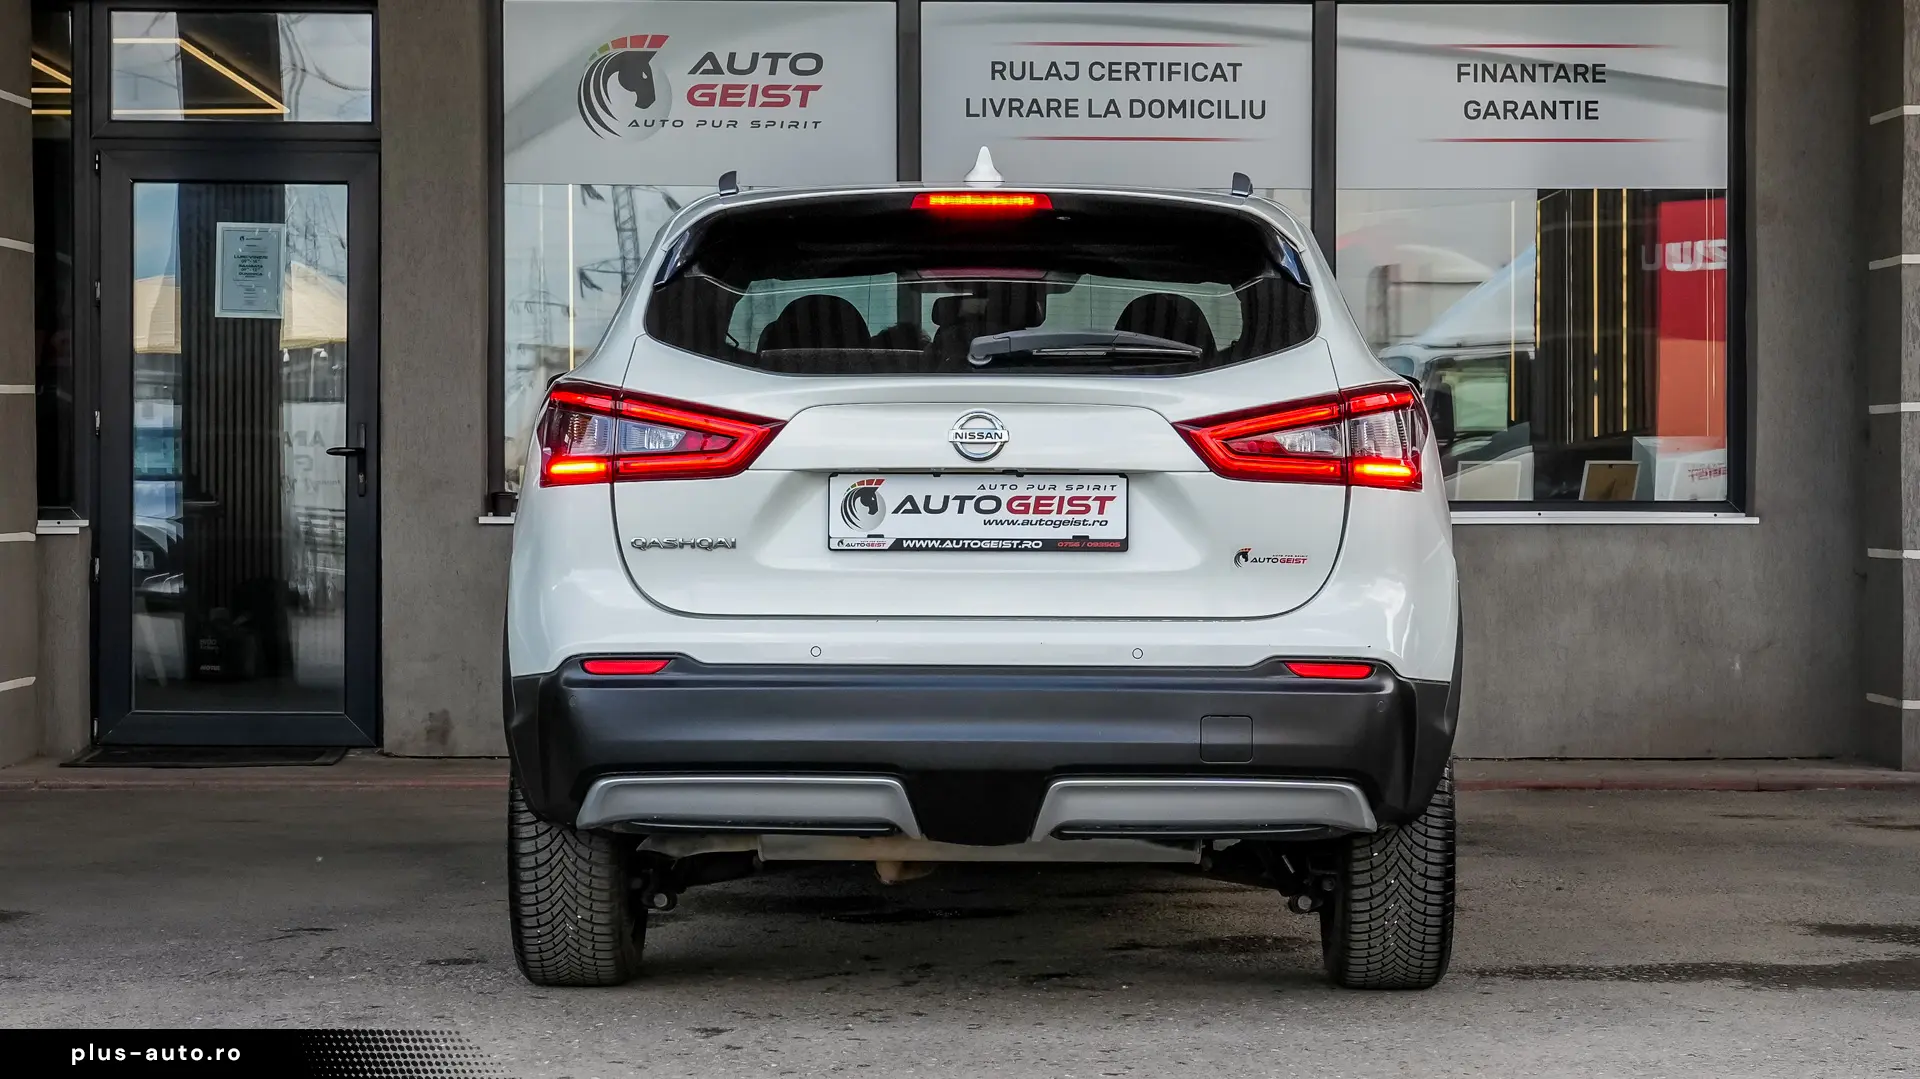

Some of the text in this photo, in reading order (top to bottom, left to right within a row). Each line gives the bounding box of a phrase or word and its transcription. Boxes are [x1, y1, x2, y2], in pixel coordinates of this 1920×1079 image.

[687, 51, 824, 76] AUTO
[990, 61, 1243, 82] RULAJ CERTIFICAT
[1456, 63, 1607, 83] FINANTARE
[686, 83, 823, 108] GEIST
[965, 97, 1266, 120] LIVRARE LA DOMICILIU
[1463, 100, 1599, 120] GARANTIE
[627, 119, 822, 129] AUTO PUR SPIRIT
[954, 431, 1003, 440] NISSAN
[891, 494, 1117, 516] AUTOGEIST
[983, 517, 1109, 528] www.autogeist.ro
[631, 536, 737, 551] QASHQAI
[902, 539, 1043, 549] WWW.AUTOGEIST.RO
